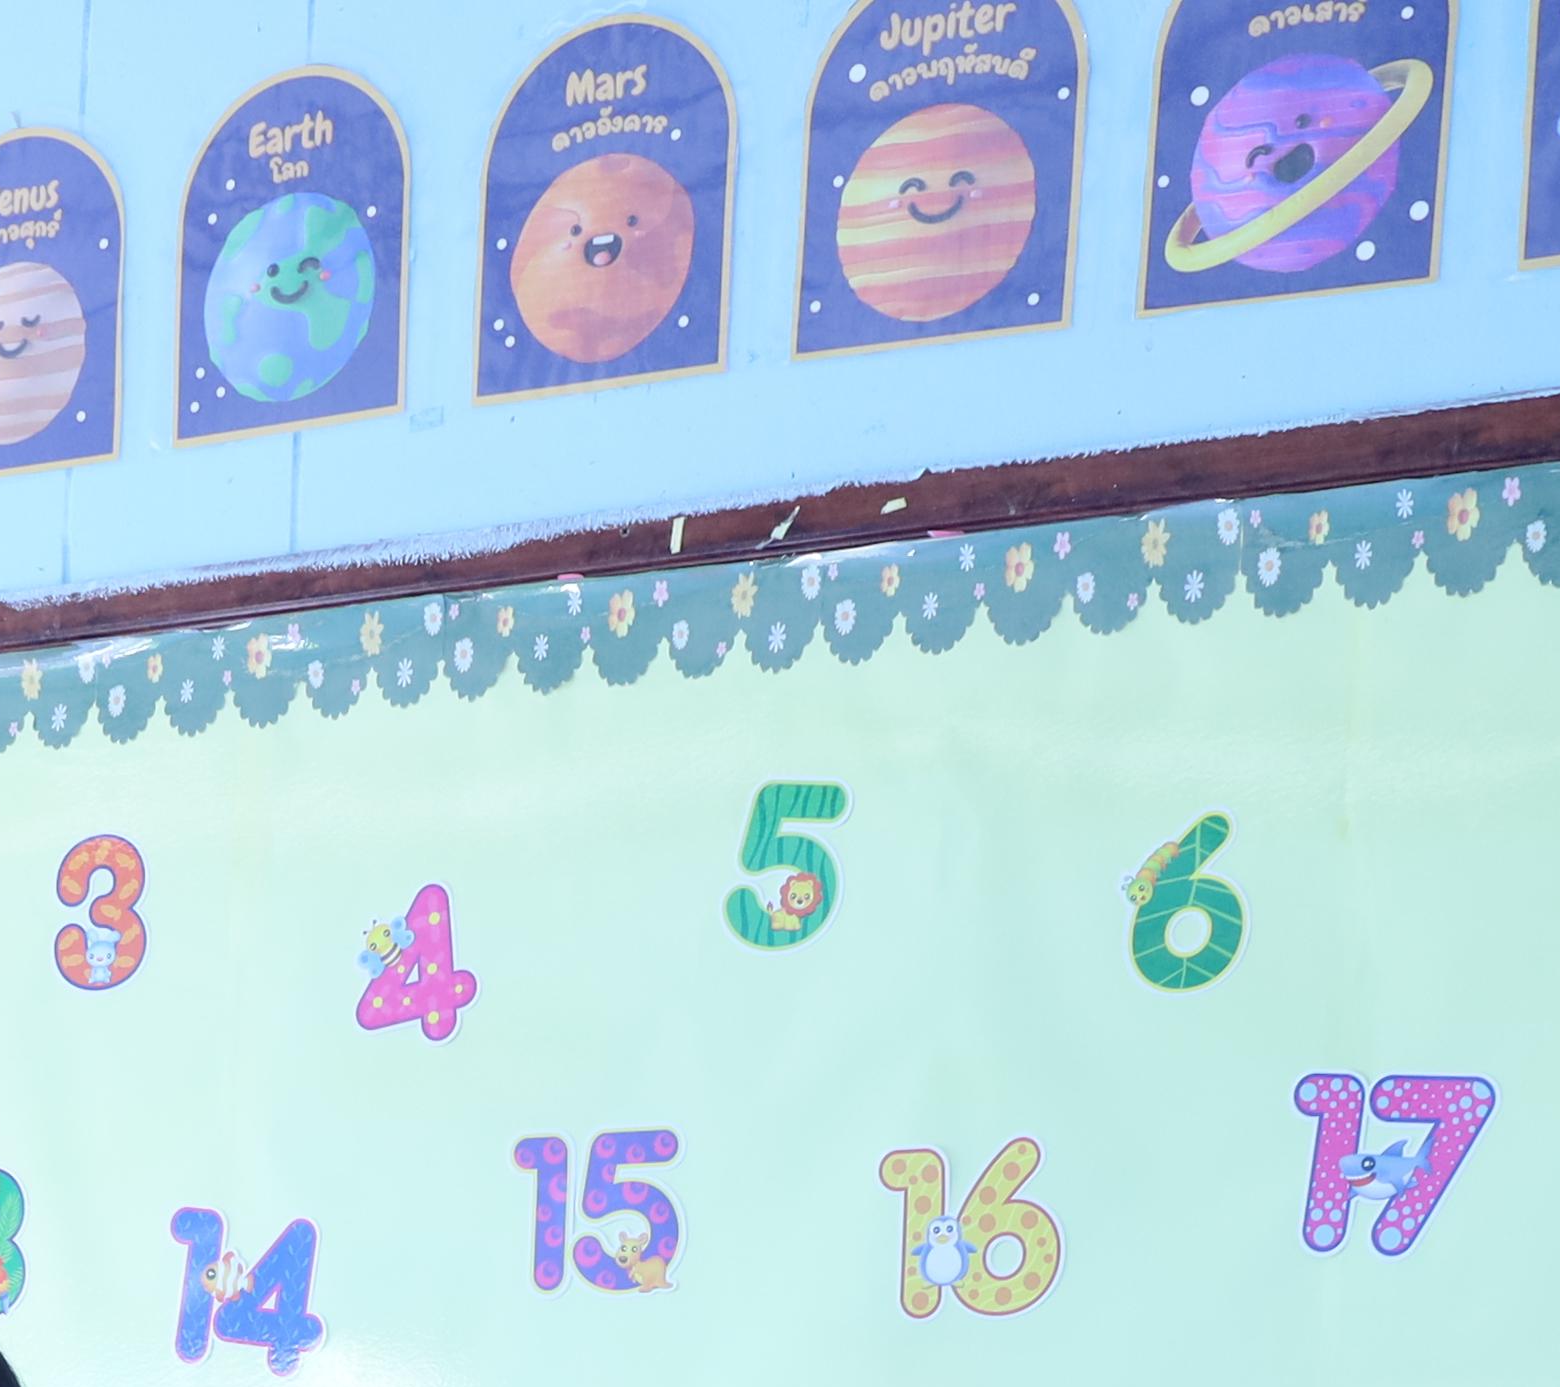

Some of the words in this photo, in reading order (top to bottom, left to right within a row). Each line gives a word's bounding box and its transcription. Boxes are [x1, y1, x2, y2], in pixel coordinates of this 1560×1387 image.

[565, 64, 649, 108] Mars
[880, 1, 1017, 56] Jupiter
[248, 109, 334, 160] Earth
[268, 156, 309, 184] โลก
[550, 105, 668, 153] ดาวอังคาร
[54, 834, 147, 990] 3
[725, 781, 847, 950] 5
[1130, 813, 1246, 993] 6
[355, 884, 478, 1041] 4
[513, 1128, 682, 1294] 15
[879, 1137, 1061, 1319] 16
[1293, 1073, 1495, 1257] 17
[170, 1206, 328, 1378] 14
